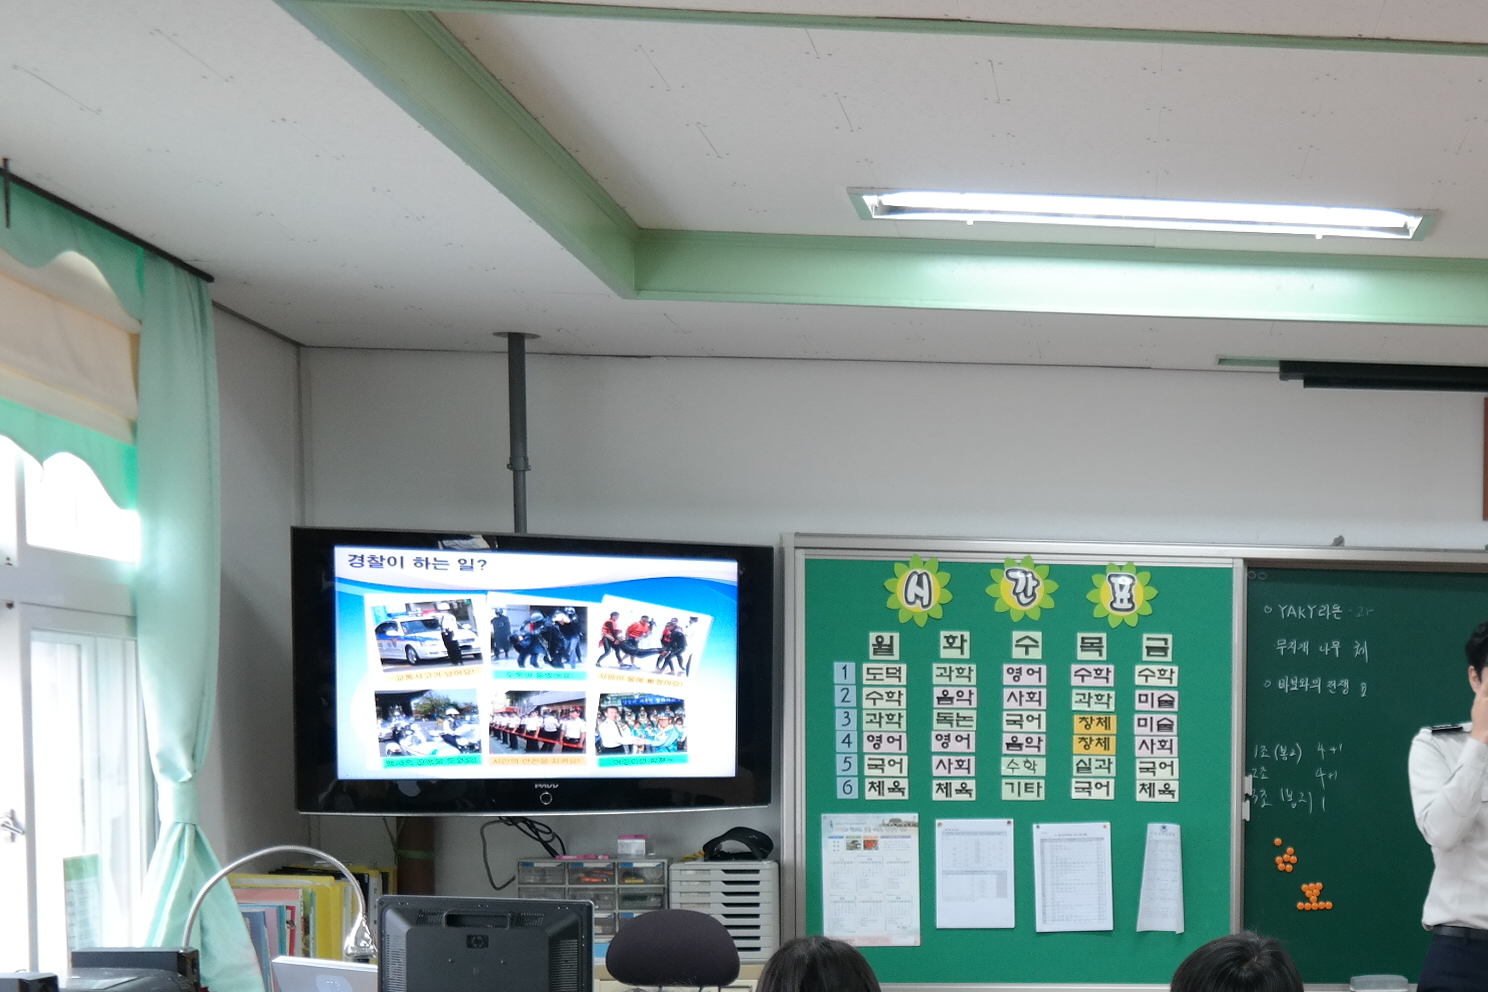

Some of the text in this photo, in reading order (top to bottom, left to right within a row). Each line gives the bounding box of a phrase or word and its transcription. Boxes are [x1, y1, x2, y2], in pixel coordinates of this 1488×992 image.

[347, 553, 488, 572] 경찰이 하는 일?
[871, 633, 1170, 658] 월 화 수 목 금
[1275, 638, 1310, 656] 무지개
[1319, 640, 1341, 658] 나무
[842, 663, 1175, 685] 1 도덕 과학 영어 수학 수학
[1278, 676, 1322, 694] 바보와의
[1326, 678, 1350, 695] 전쟁
[840, 686, 1175, 709] 2 수학 음악 사회 과학 미술
[841, 709, 852, 727] 3
[865, 710, 904, 729] 과학
[1005, 712, 1042, 730] 국어
[1078, 715, 1111, 731] 창체
[1137, 715, 1174, 733] 미술
[841, 732, 1173, 755] 4 영어 영어 음악 창체 사회
[841, 755, 1174, 777] 5 국어 사회 수학 실과 국어
[842, 778, 1176, 799] 6 체육 체육 기타 국어 체육
